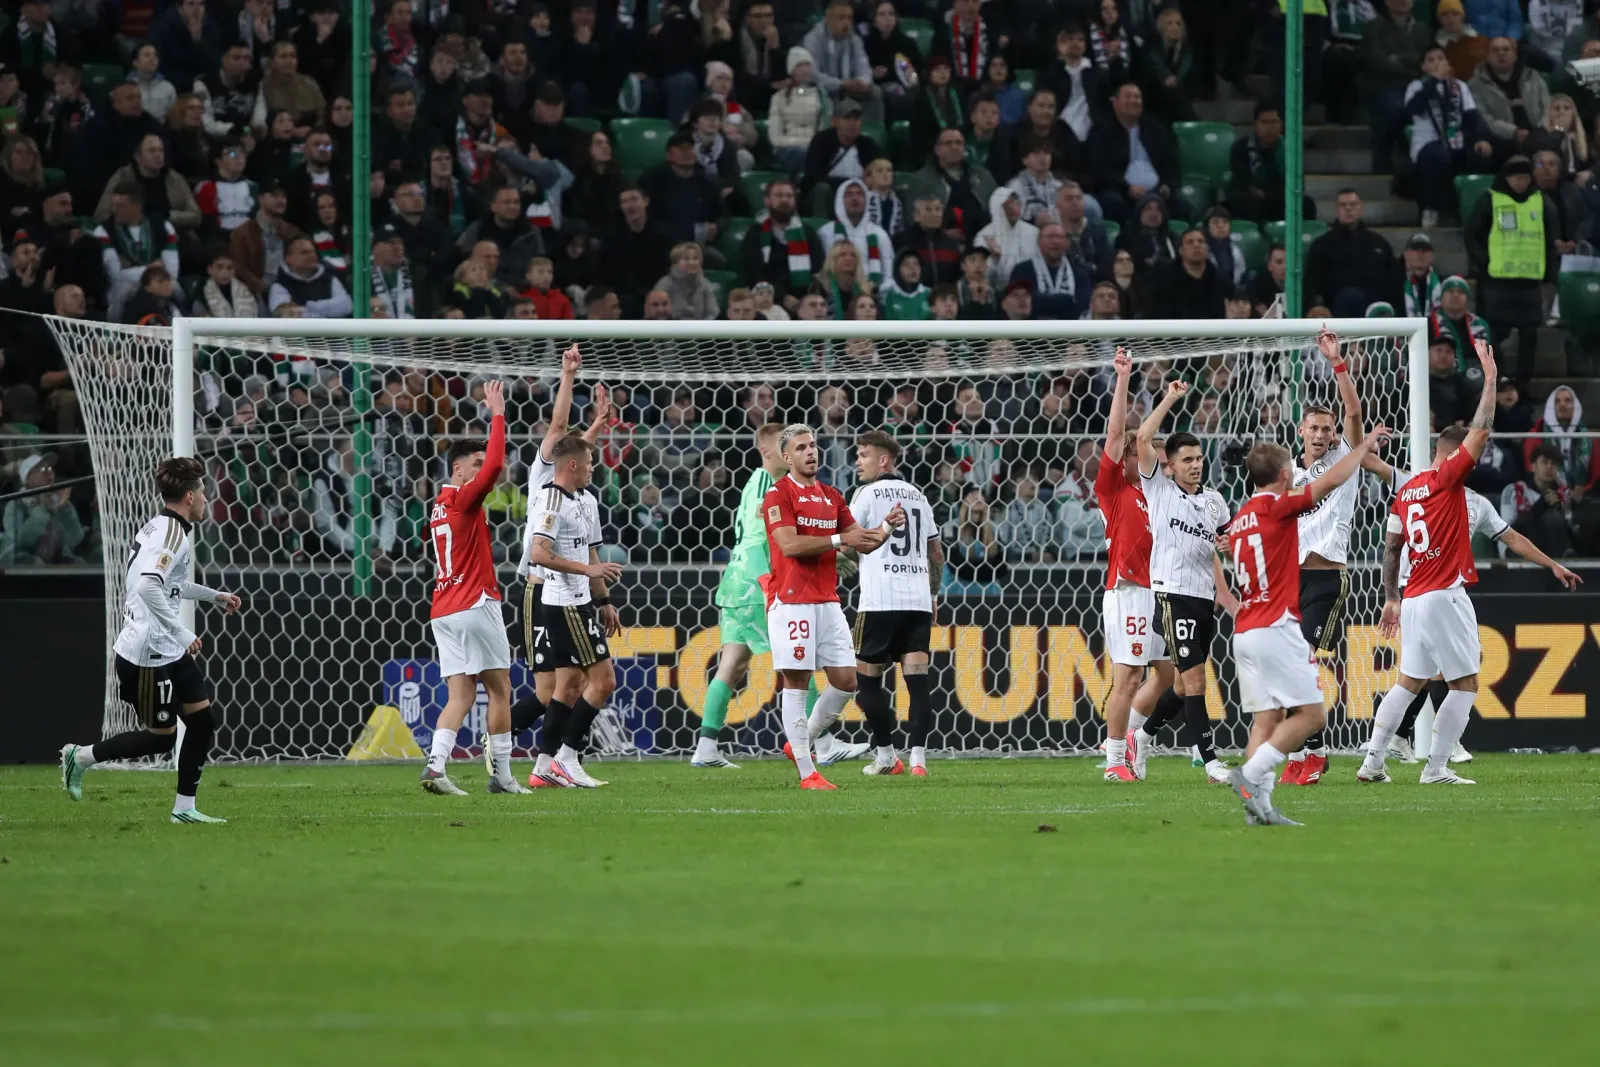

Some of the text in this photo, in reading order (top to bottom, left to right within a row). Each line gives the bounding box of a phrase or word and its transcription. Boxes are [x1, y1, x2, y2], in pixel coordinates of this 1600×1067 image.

[889, 506, 921, 557] 91
[1407, 503, 1429, 553] 6
[431, 524, 452, 579] 17
[1233, 533, 1269, 595] 41
[588, 618, 600, 638] 4
[788, 620, 809, 640] 29
[1126, 616, 1146, 635] 52
[1175, 619, 1196, 640] 67
[157, 679, 173, 704] 17
